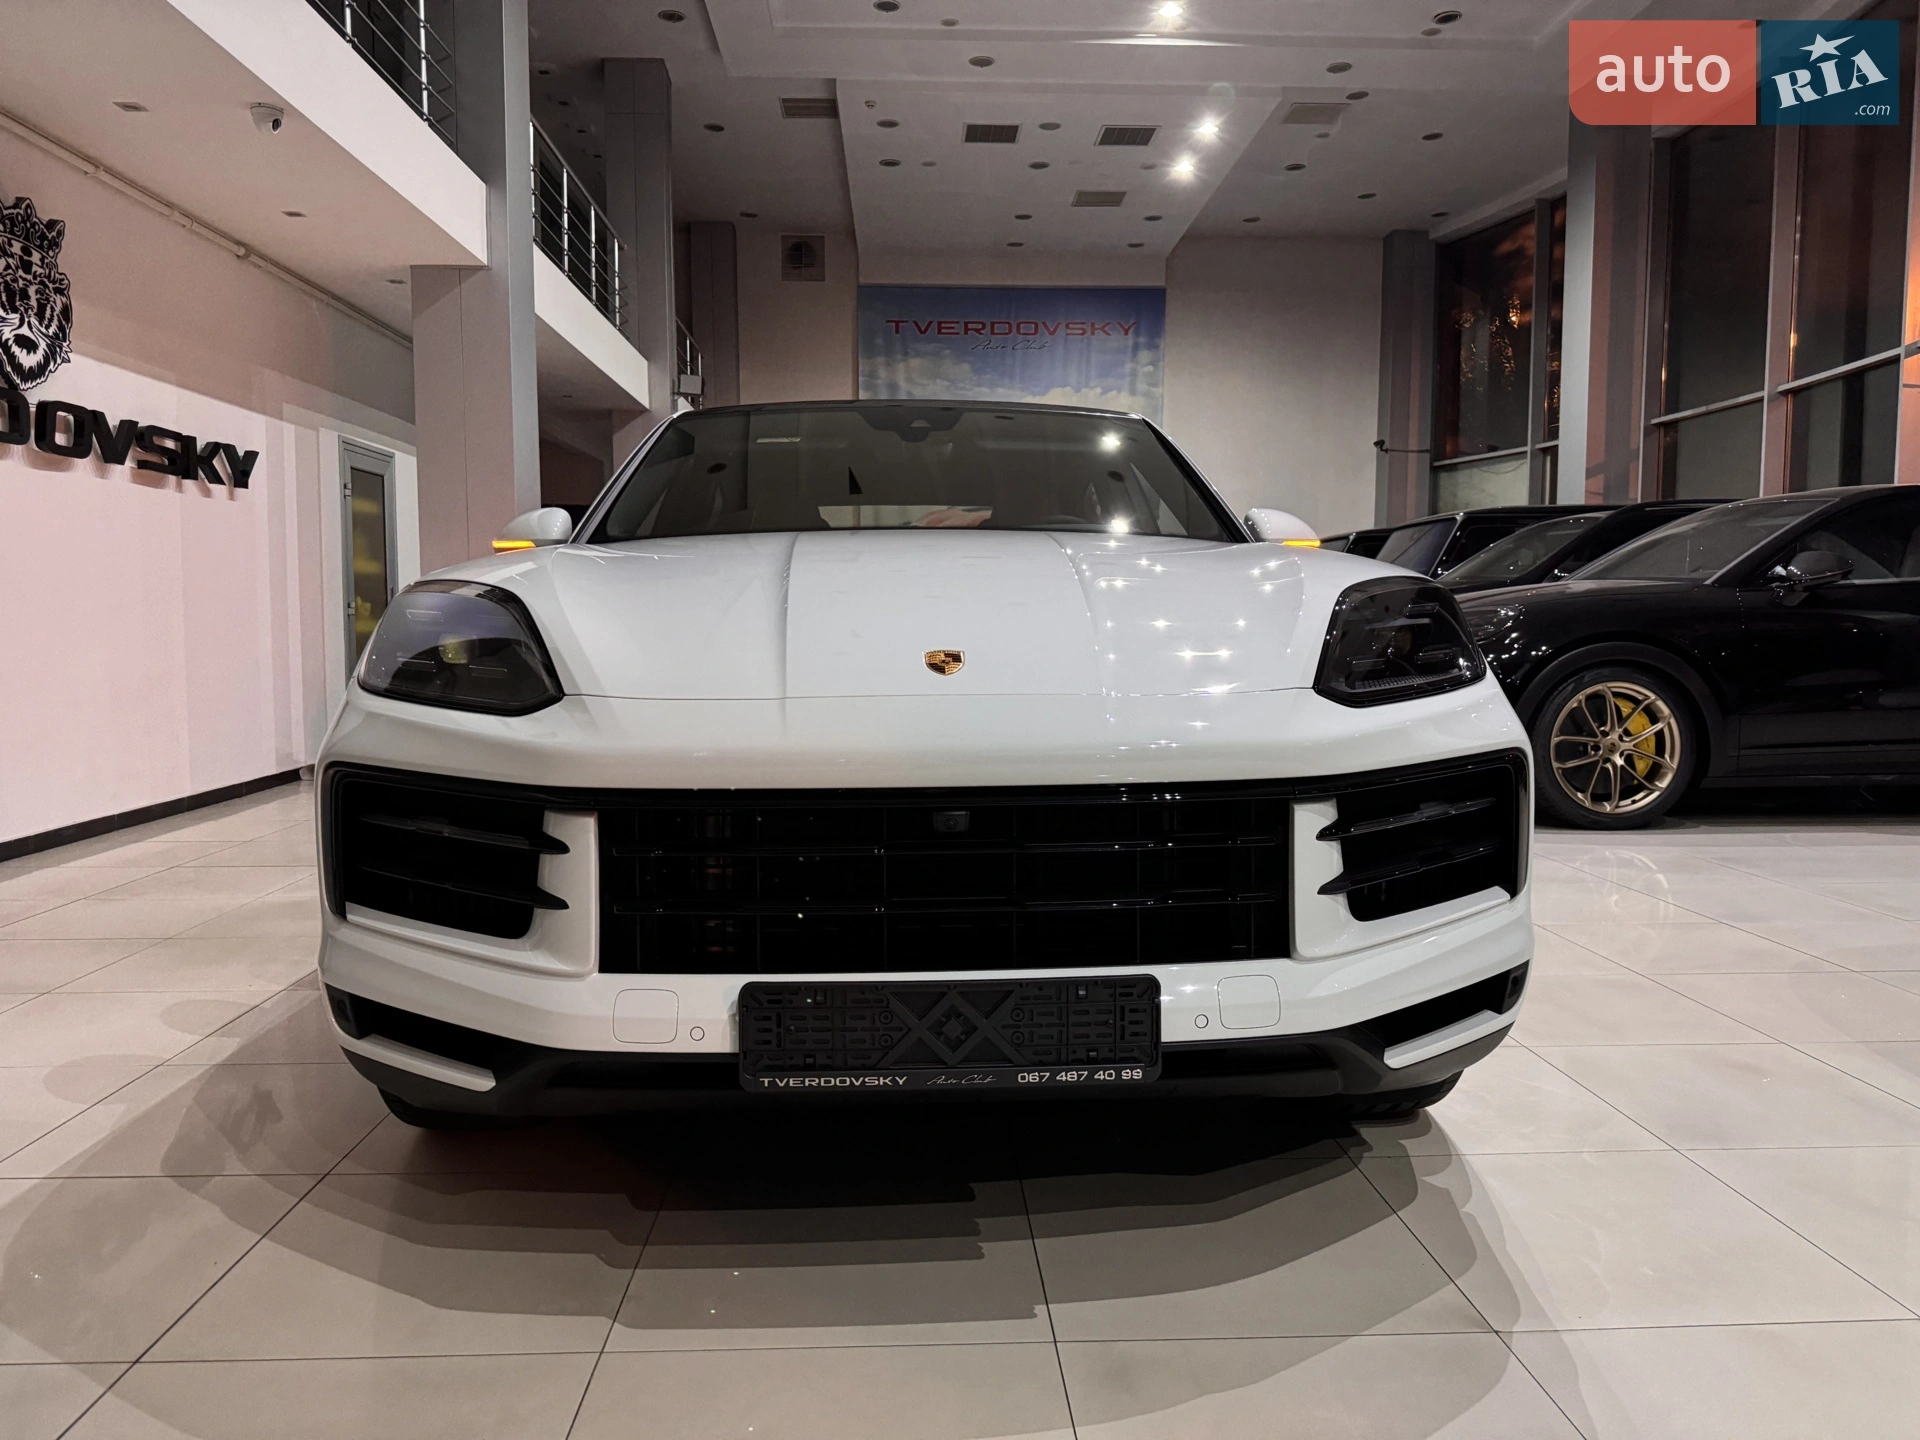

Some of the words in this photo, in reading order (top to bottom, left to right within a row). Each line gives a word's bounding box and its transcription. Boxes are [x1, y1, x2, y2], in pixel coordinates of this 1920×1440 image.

[885, 319, 1138, 337] TVERDOVSKY
[970, 339, 1007, 351] Auto
[1011, 339, 1053, 351] Club
[759, 1075, 908, 1088] TVERDOVSKY
[926, 1074, 960, 1086] Auto
[961, 1073, 997, 1085] Club
[1017, 1072, 1050, 1083] 067
[1055, 1070, 1088, 1082] 487
[1094, 1069, 1116, 1081] 40
[1121, 1068, 1143, 1080] 99
